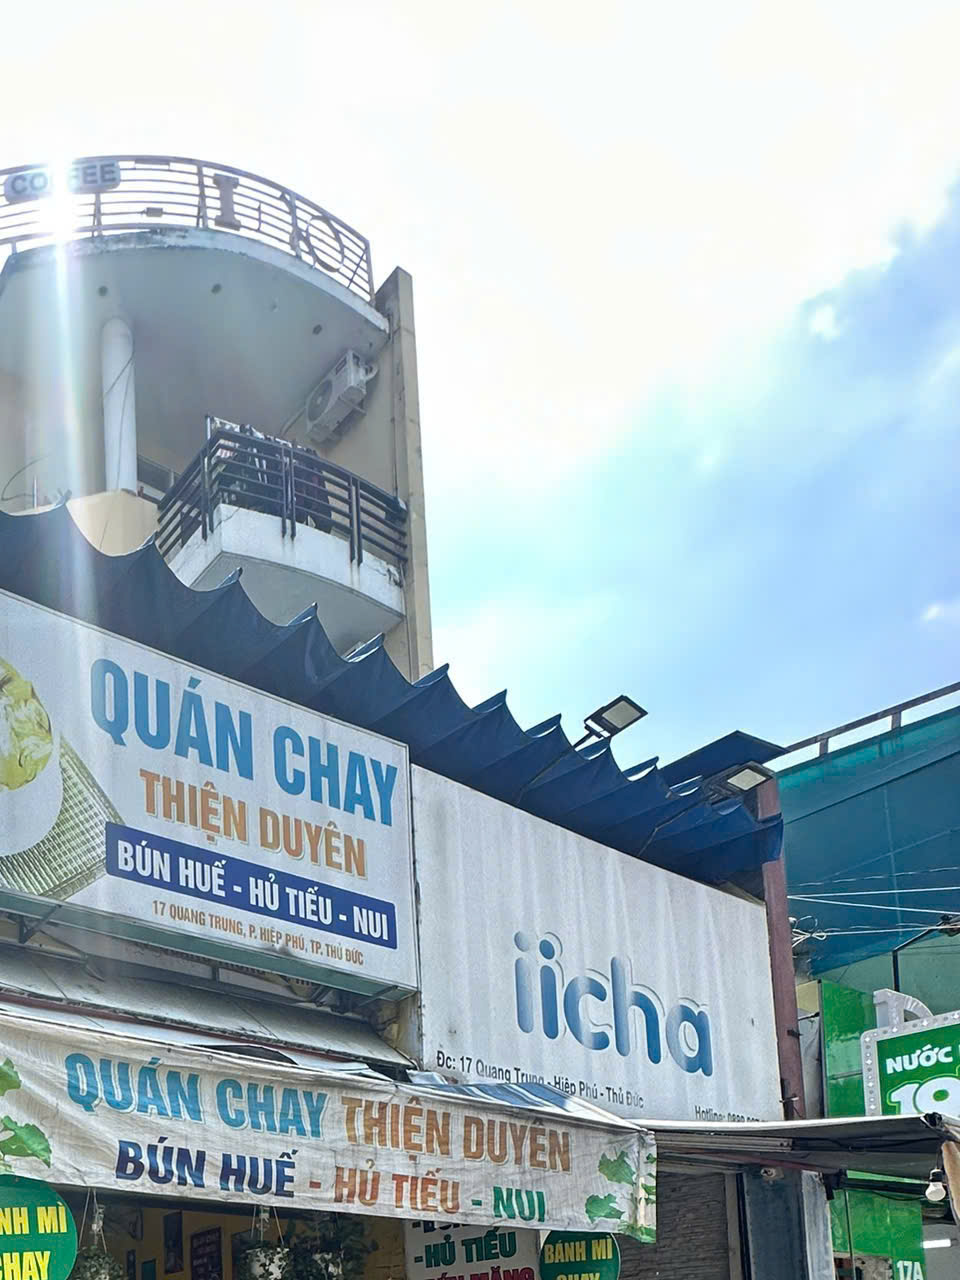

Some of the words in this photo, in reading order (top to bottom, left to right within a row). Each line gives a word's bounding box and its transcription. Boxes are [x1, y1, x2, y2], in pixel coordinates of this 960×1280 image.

[11, 163, 116, 194] COFEE
[90, 658, 254, 780] QUÁN
[273, 725, 397, 827] CHAY
[140, 769, 248, 846] THIỆN
[259, 806, 368, 880] DUYÊN
[117, 838, 172, 882] BÚN
[179, 858, 227, 897] HUẾ
[249, 873, 280, 912] HỦ
[285, 886, 333, 926] TIẾU
[353, 904, 389, 941] NUI
[152, 900, 165, 917] 17
[169, 904, 206, 926] QUANG
[208, 914, 246, 938] TRUNG,
[248, 923, 258, 939] P.
[260, 923, 283, 947] HIỆP
[285, 931, 308, 953] PHÚ,
[310, 939, 323, 956] TP.
[325, 941, 343, 961] THỦ
[345, 948, 364, 965] ĐỨC
[514, 931, 714, 1077] iicha
[436, 1050, 456, 1070] Đc:
[459, 1056, 472, 1074] 17
[476, 1059, 511, 1084] Quang
[579, 1081, 598, 1100] Phú
[605, 1086, 624, 1104] Thủ
[626, 1090, 644, 1109] Đức
[886, 1044, 953, 1075] NƯỚC
[65, 1053, 204, 1122] QUÁN
[216, 1078, 328, 1138] CHAY
[341, 1096, 451, 1162] THIỆN
[463, 1117, 571, 1174] DUYÊN
[115, 1136, 206, 1188] BÚN
[219, 1149, 299, 1198] HUẾ
[334, 1158, 380, 1206] HỦ
[392, 1168, 460, 1214] TIẾU
[493, 1186, 545, 1222] NUI
[37, 1202, 67, 1233] MÌ
[462, 1226, 517, 1264] TIẾU
[544, 1240, 585, 1264] BÁNH
[592, 1236, 613, 1260] MÌ
